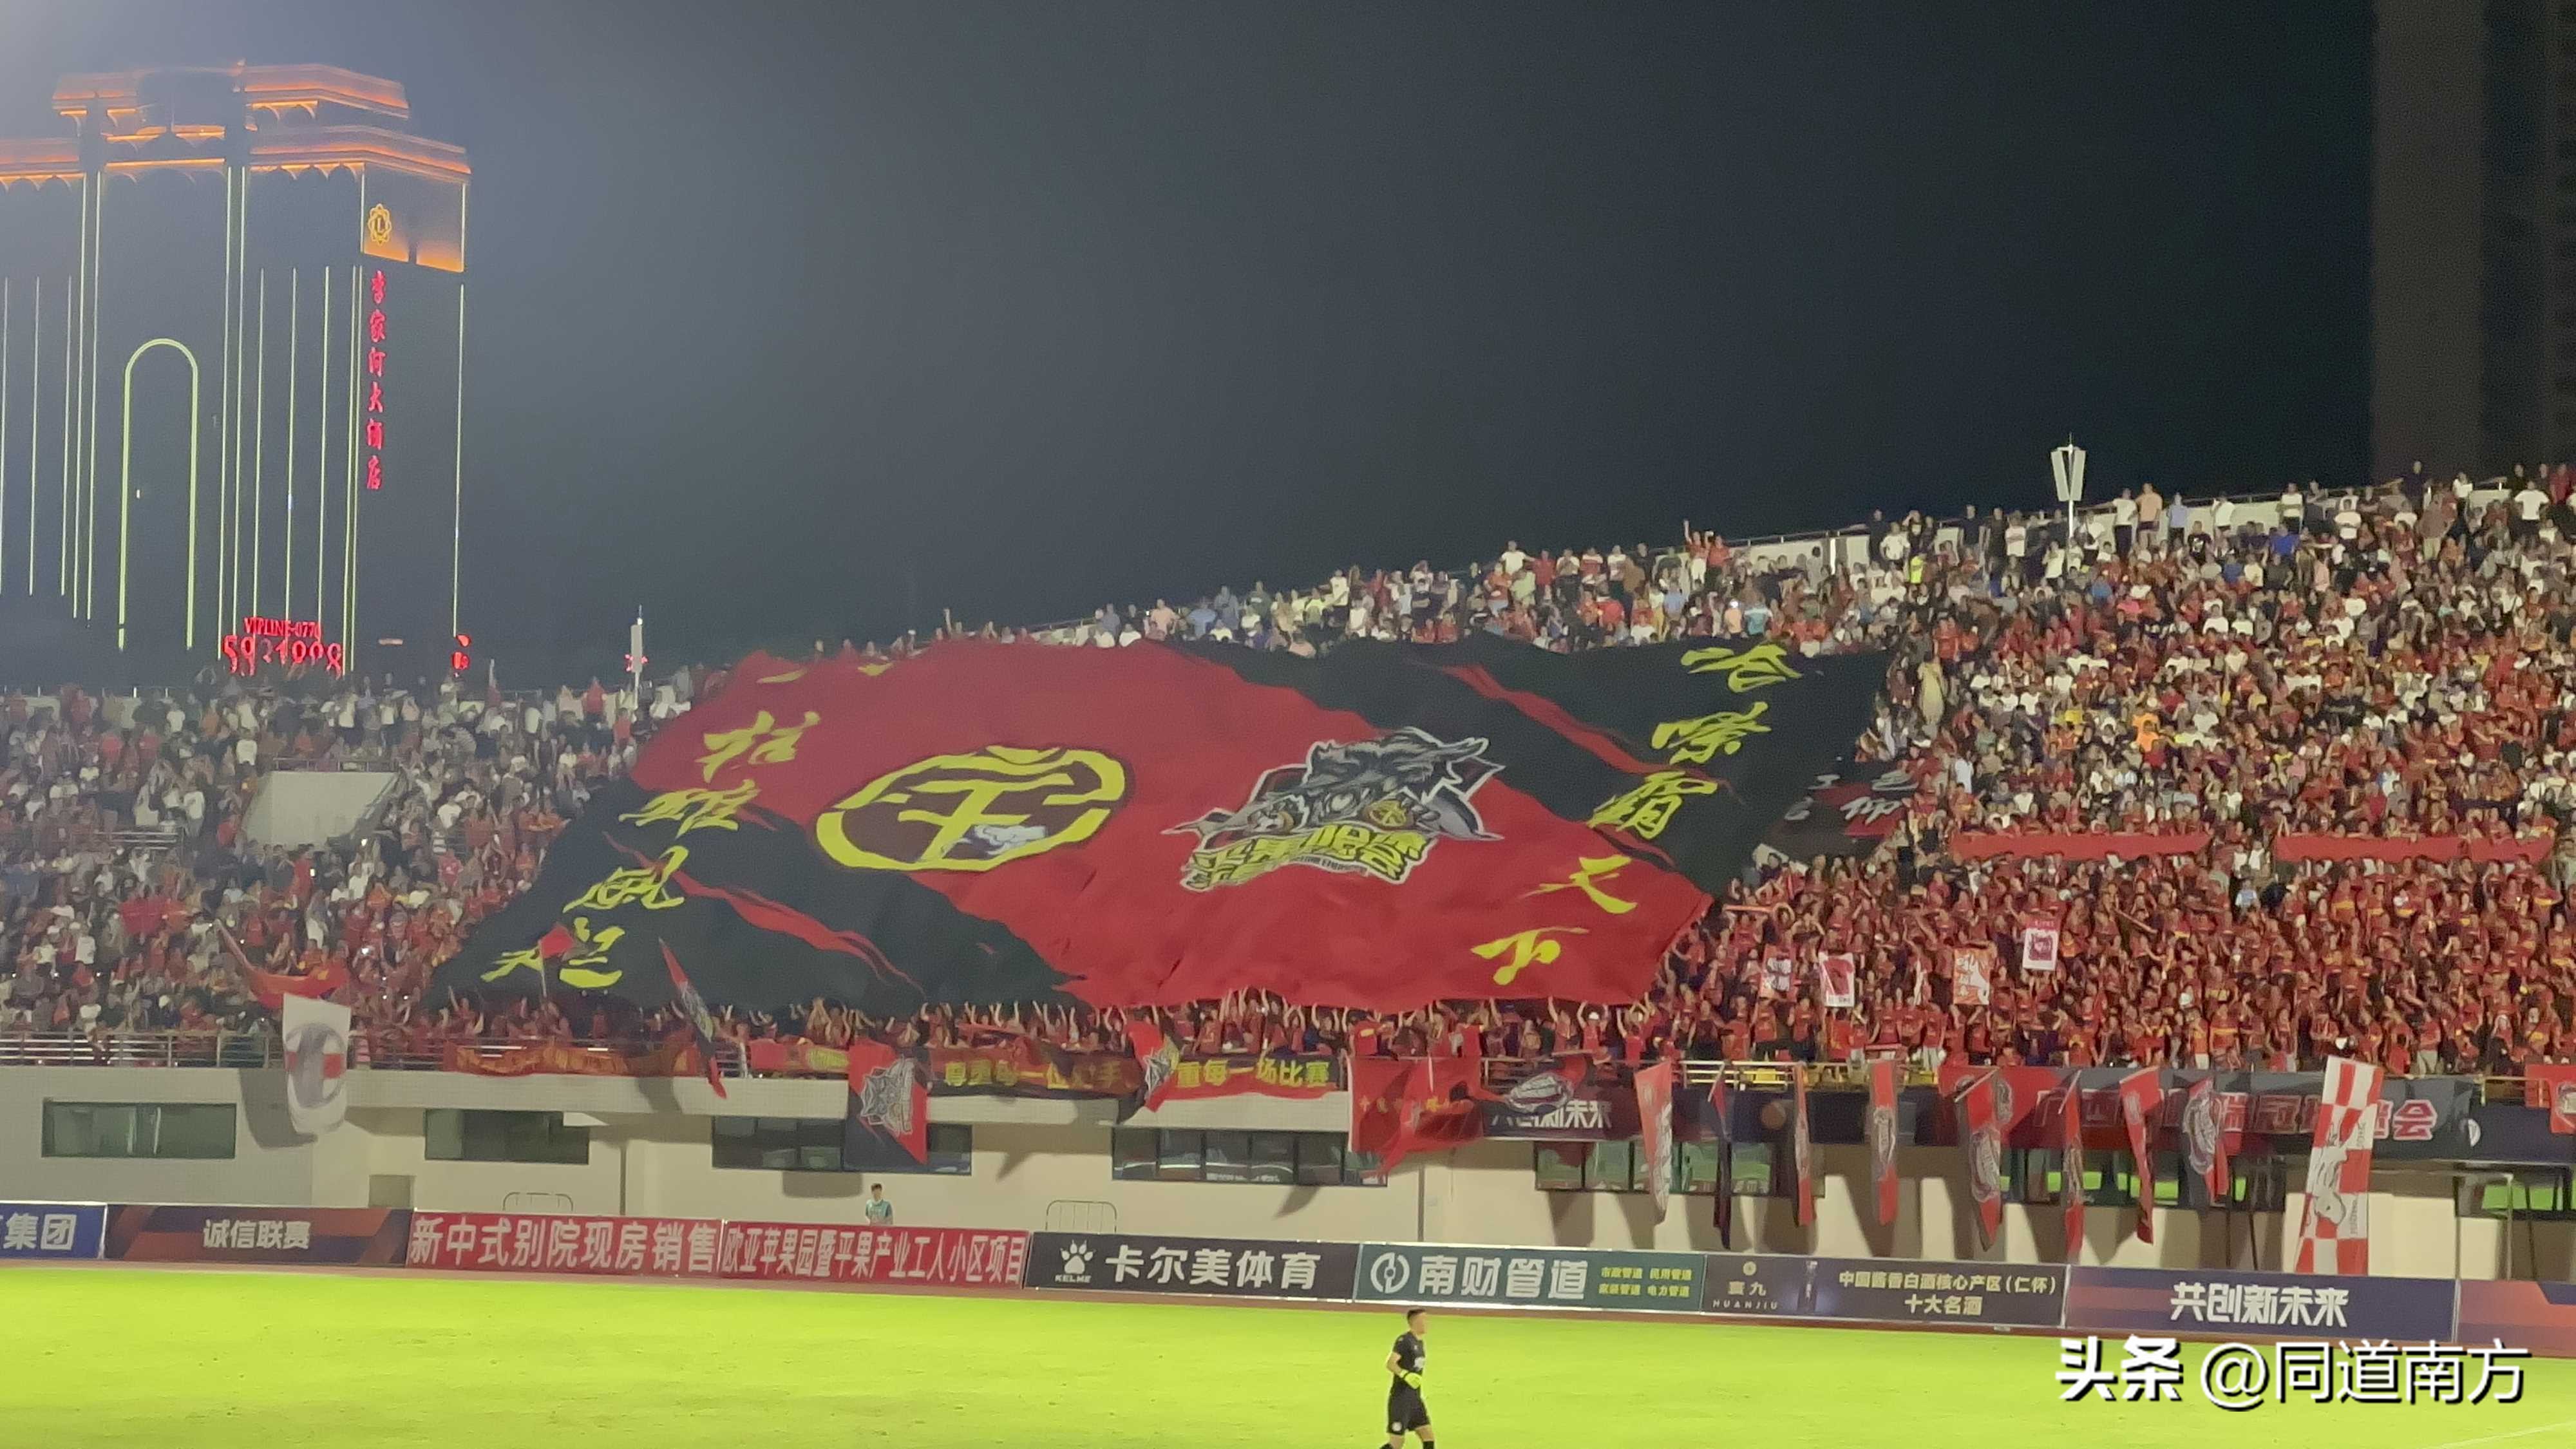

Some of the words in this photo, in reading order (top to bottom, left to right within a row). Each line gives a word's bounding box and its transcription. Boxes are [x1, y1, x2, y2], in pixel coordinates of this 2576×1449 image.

[0, 1212, 77, 1251] 集团
[203, 1219, 312, 1250] 诚信联赛
[410, 1216, 718, 1273] 新中式别院现房销售
[1055, 1274, 1092, 1283] KELME
[1105, 1244, 1321, 1290] 卡尔美体育
[1419, 1255, 1588, 1300] 南财管道
[1713, 1299, 1778, 1310] HUANJIU
[1904, 1293, 1983, 1316] 十大名酒
[2170, 1282, 2349, 1327] 共创新未来
